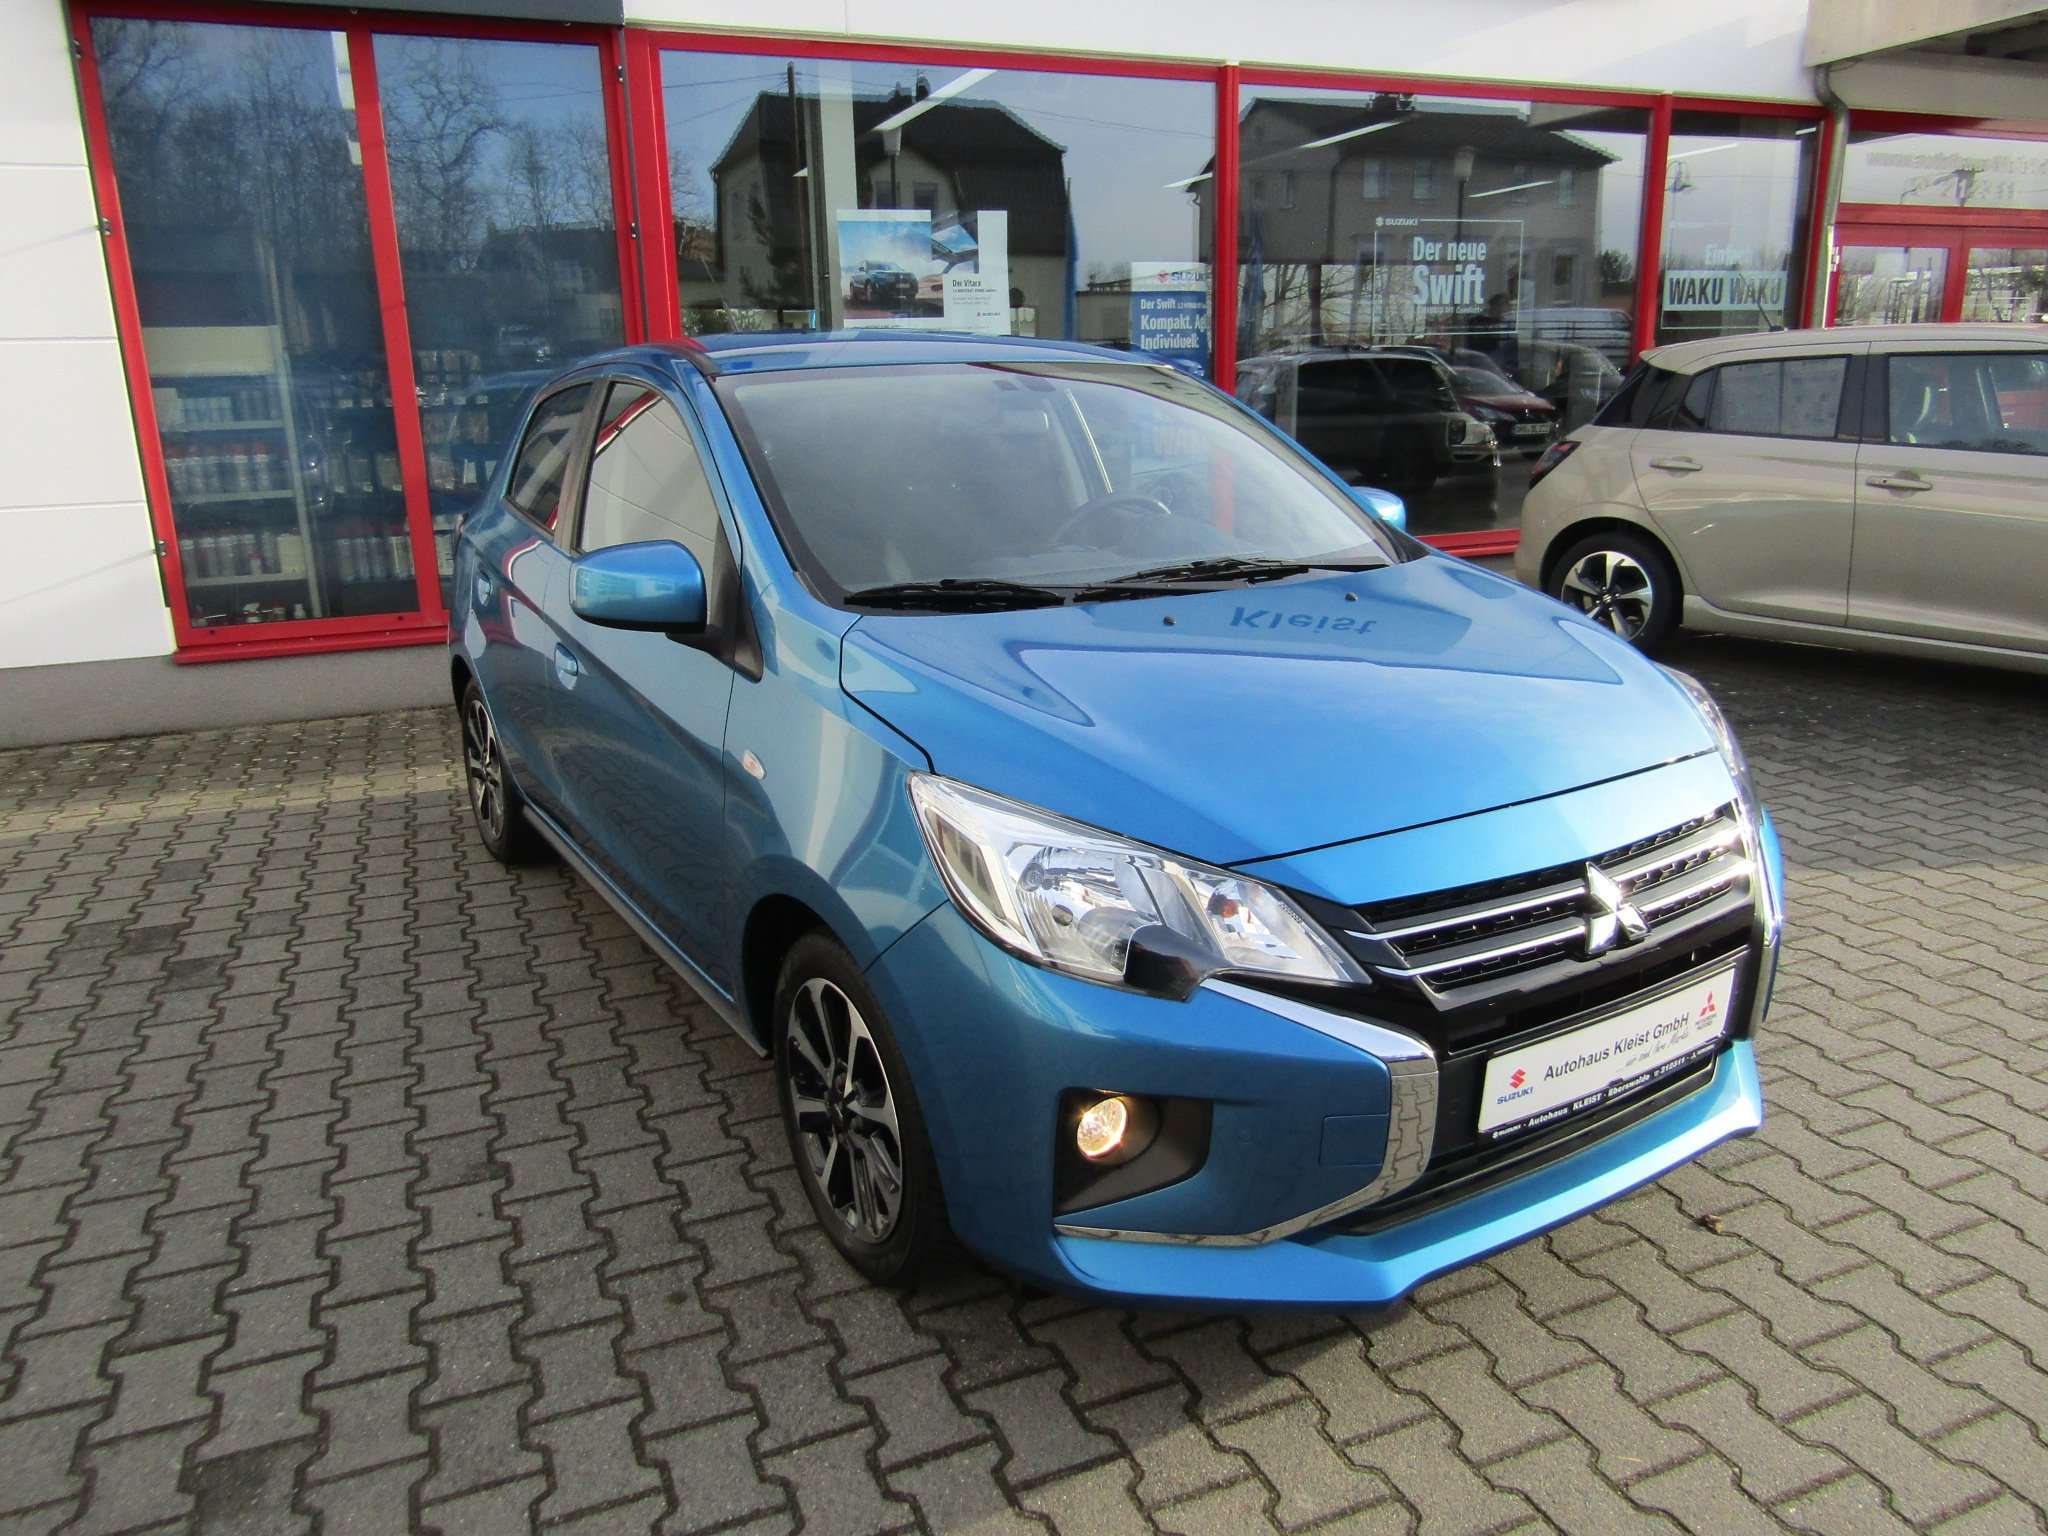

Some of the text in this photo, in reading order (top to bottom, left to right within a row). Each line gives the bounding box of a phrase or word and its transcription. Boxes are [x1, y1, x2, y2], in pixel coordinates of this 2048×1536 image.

[1413, 236, 1487, 261] Der neue
[1413, 264, 1485, 305] Swift
[1669, 277, 1783, 305] WAKU WAKU
[1141, 299, 1154, 310] Der
[1156, 298, 1177, 311] Swift
[1141, 314, 1193, 333] Kompakt.
[1543, 1047, 1611, 1081] Autohaus
[1613, 1031, 1650, 1056] Kleist
[1653, 1011, 1690, 1039] GmbH
[1496, 1085, 1535, 1105] SUZUKI
[1527, 1107, 1569, 1128] Autohaus
[1572, 1093, 1603, 1112] KLEIST
